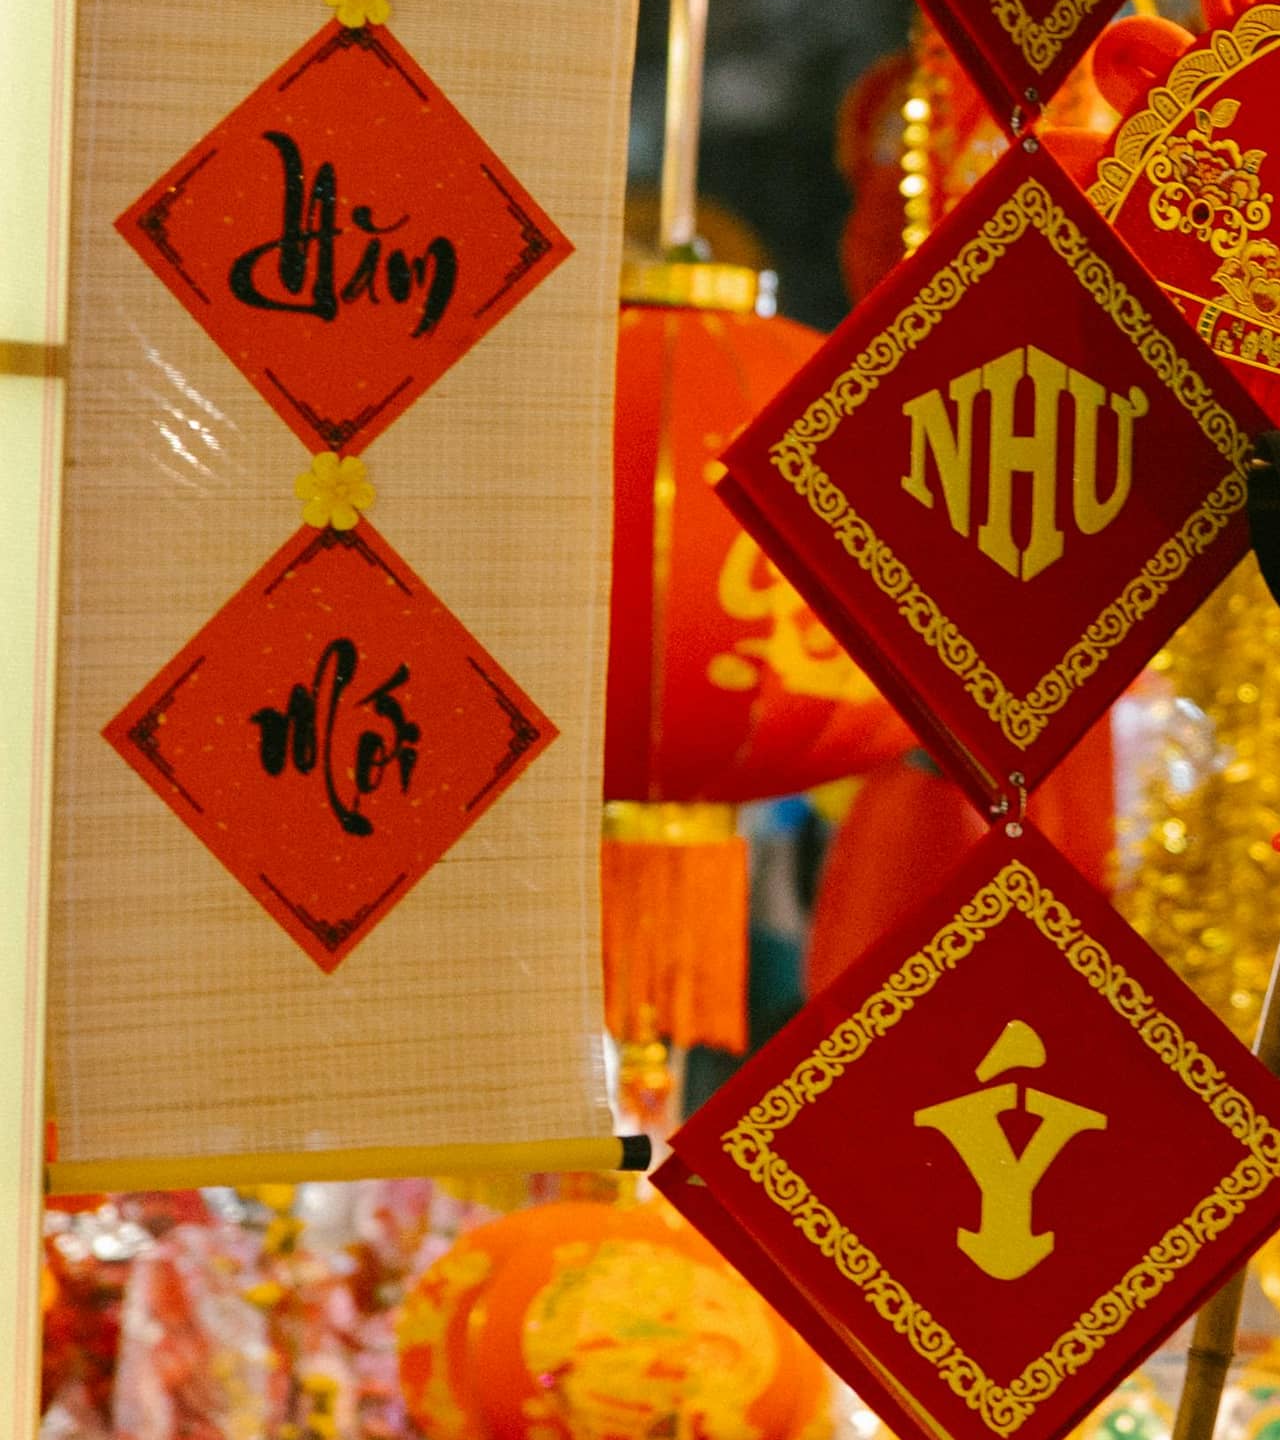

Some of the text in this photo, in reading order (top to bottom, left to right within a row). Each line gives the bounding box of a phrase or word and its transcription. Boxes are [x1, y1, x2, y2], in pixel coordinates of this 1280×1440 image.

[229, 130, 458, 338] Năm
[901, 345, 1150, 582] NHƯ
[250, 637, 422, 838] Mới
[914, 1019, 1108, 1281] Ý
